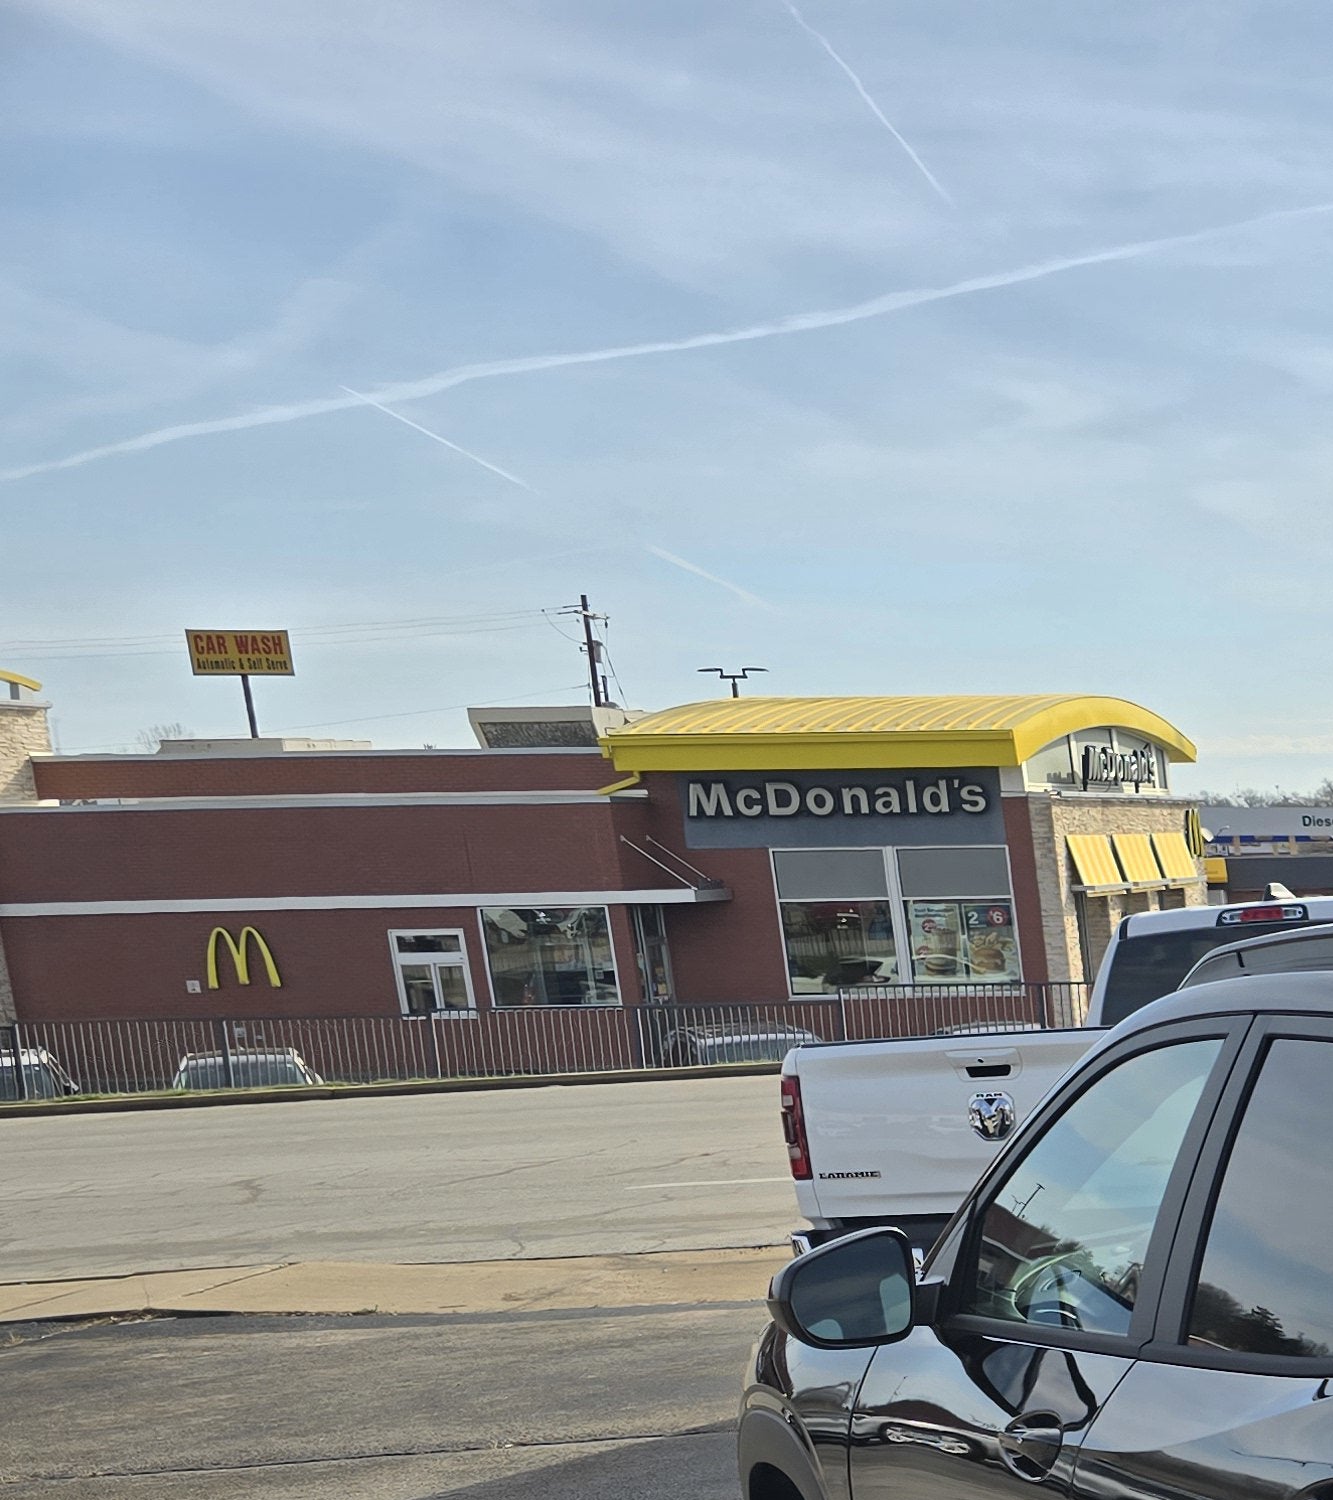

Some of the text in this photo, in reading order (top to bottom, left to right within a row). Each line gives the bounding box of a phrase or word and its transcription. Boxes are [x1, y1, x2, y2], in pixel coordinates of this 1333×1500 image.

[193, 634, 284, 655] CAR WASH
[196, 657, 235, 670] Automatic
[247, 657, 264, 670] Self
[265, 657, 289, 670] Serve
[687, 778, 988, 817] McDonald's
